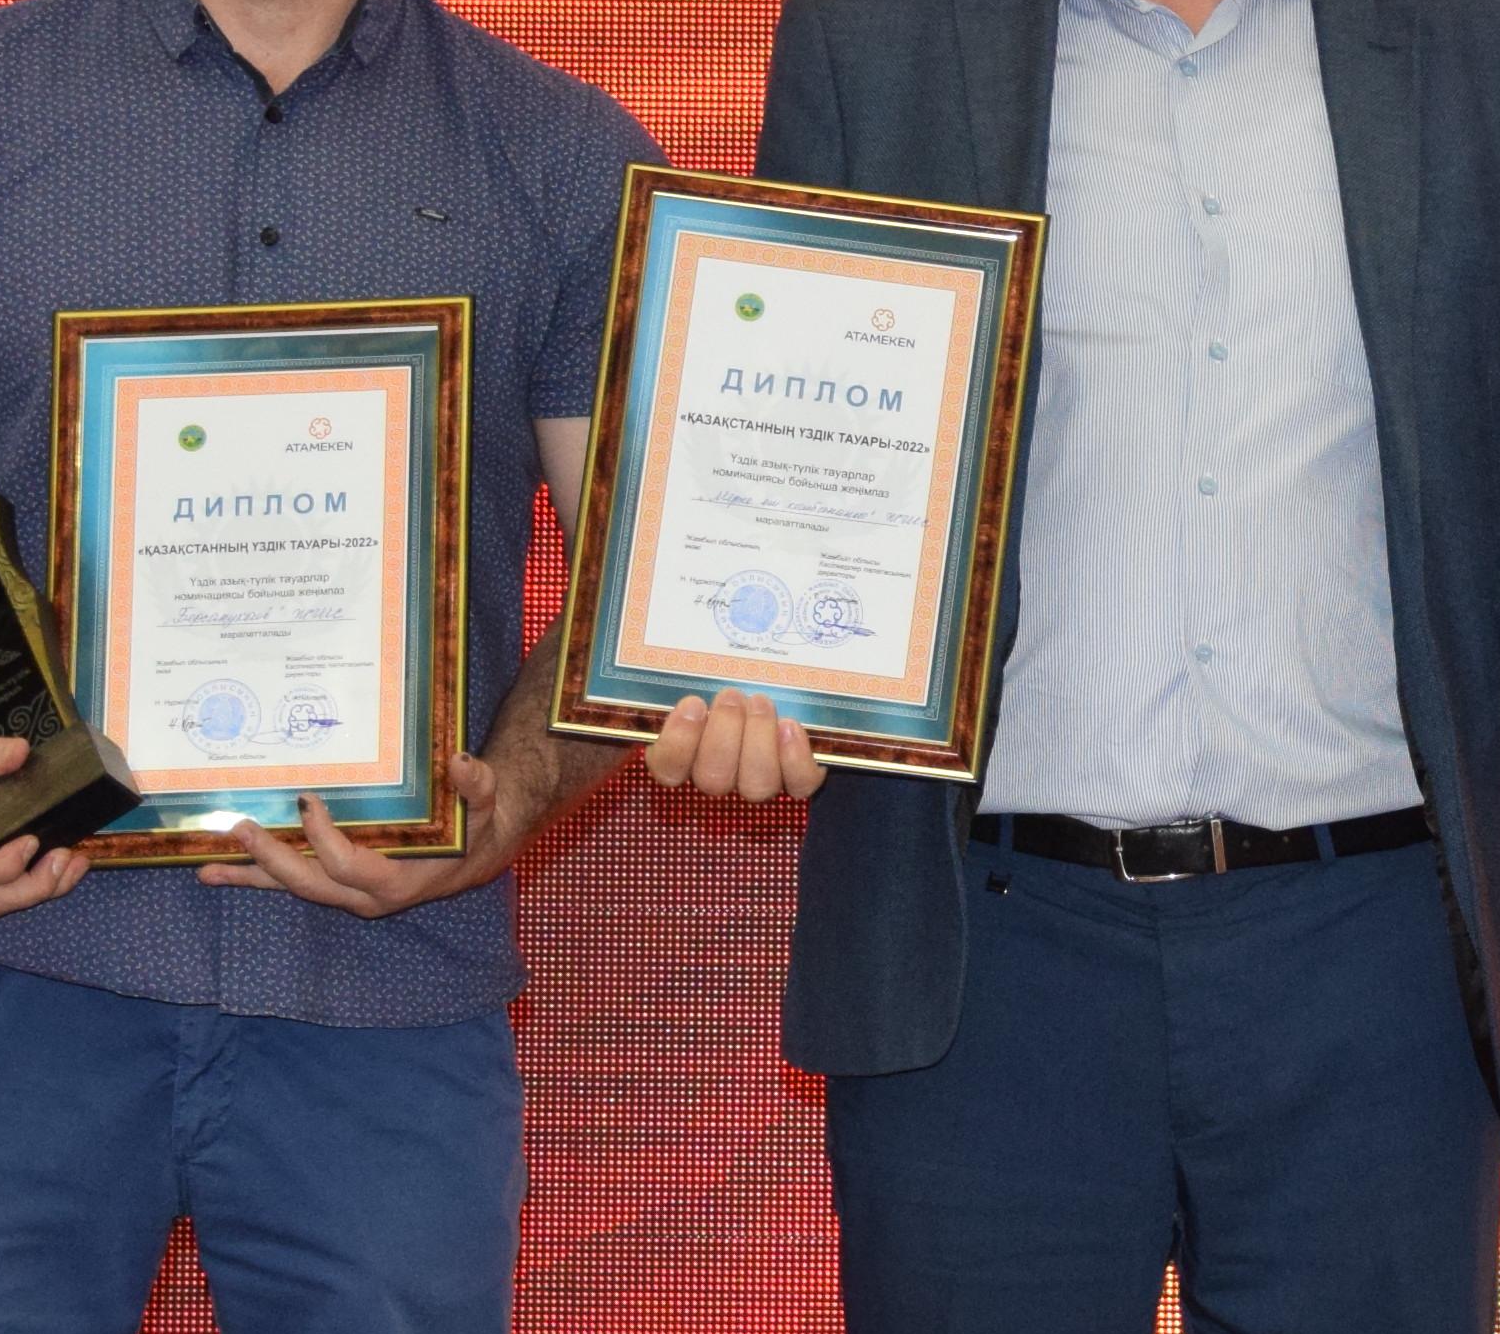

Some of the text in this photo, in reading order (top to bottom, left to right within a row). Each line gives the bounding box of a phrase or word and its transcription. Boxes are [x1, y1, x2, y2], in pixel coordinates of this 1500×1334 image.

[844, 330, 916, 349] ATAMEKEN
[719, 367, 904, 413] ДИПЛОМ
[680, 411, 931, 454] «ҚАЗАҚСТАННЫҢ ҮЗДІК ТАУАРЫ-2022»
[285, 441, 354, 453] ATAMEKEN
[173, 491, 348, 523] ДИПЛОМ
[138, 537, 379, 557] «ҚАЗАҚСТАННЫҢ ҮЗДІК ТАУАРЫ-2022»
